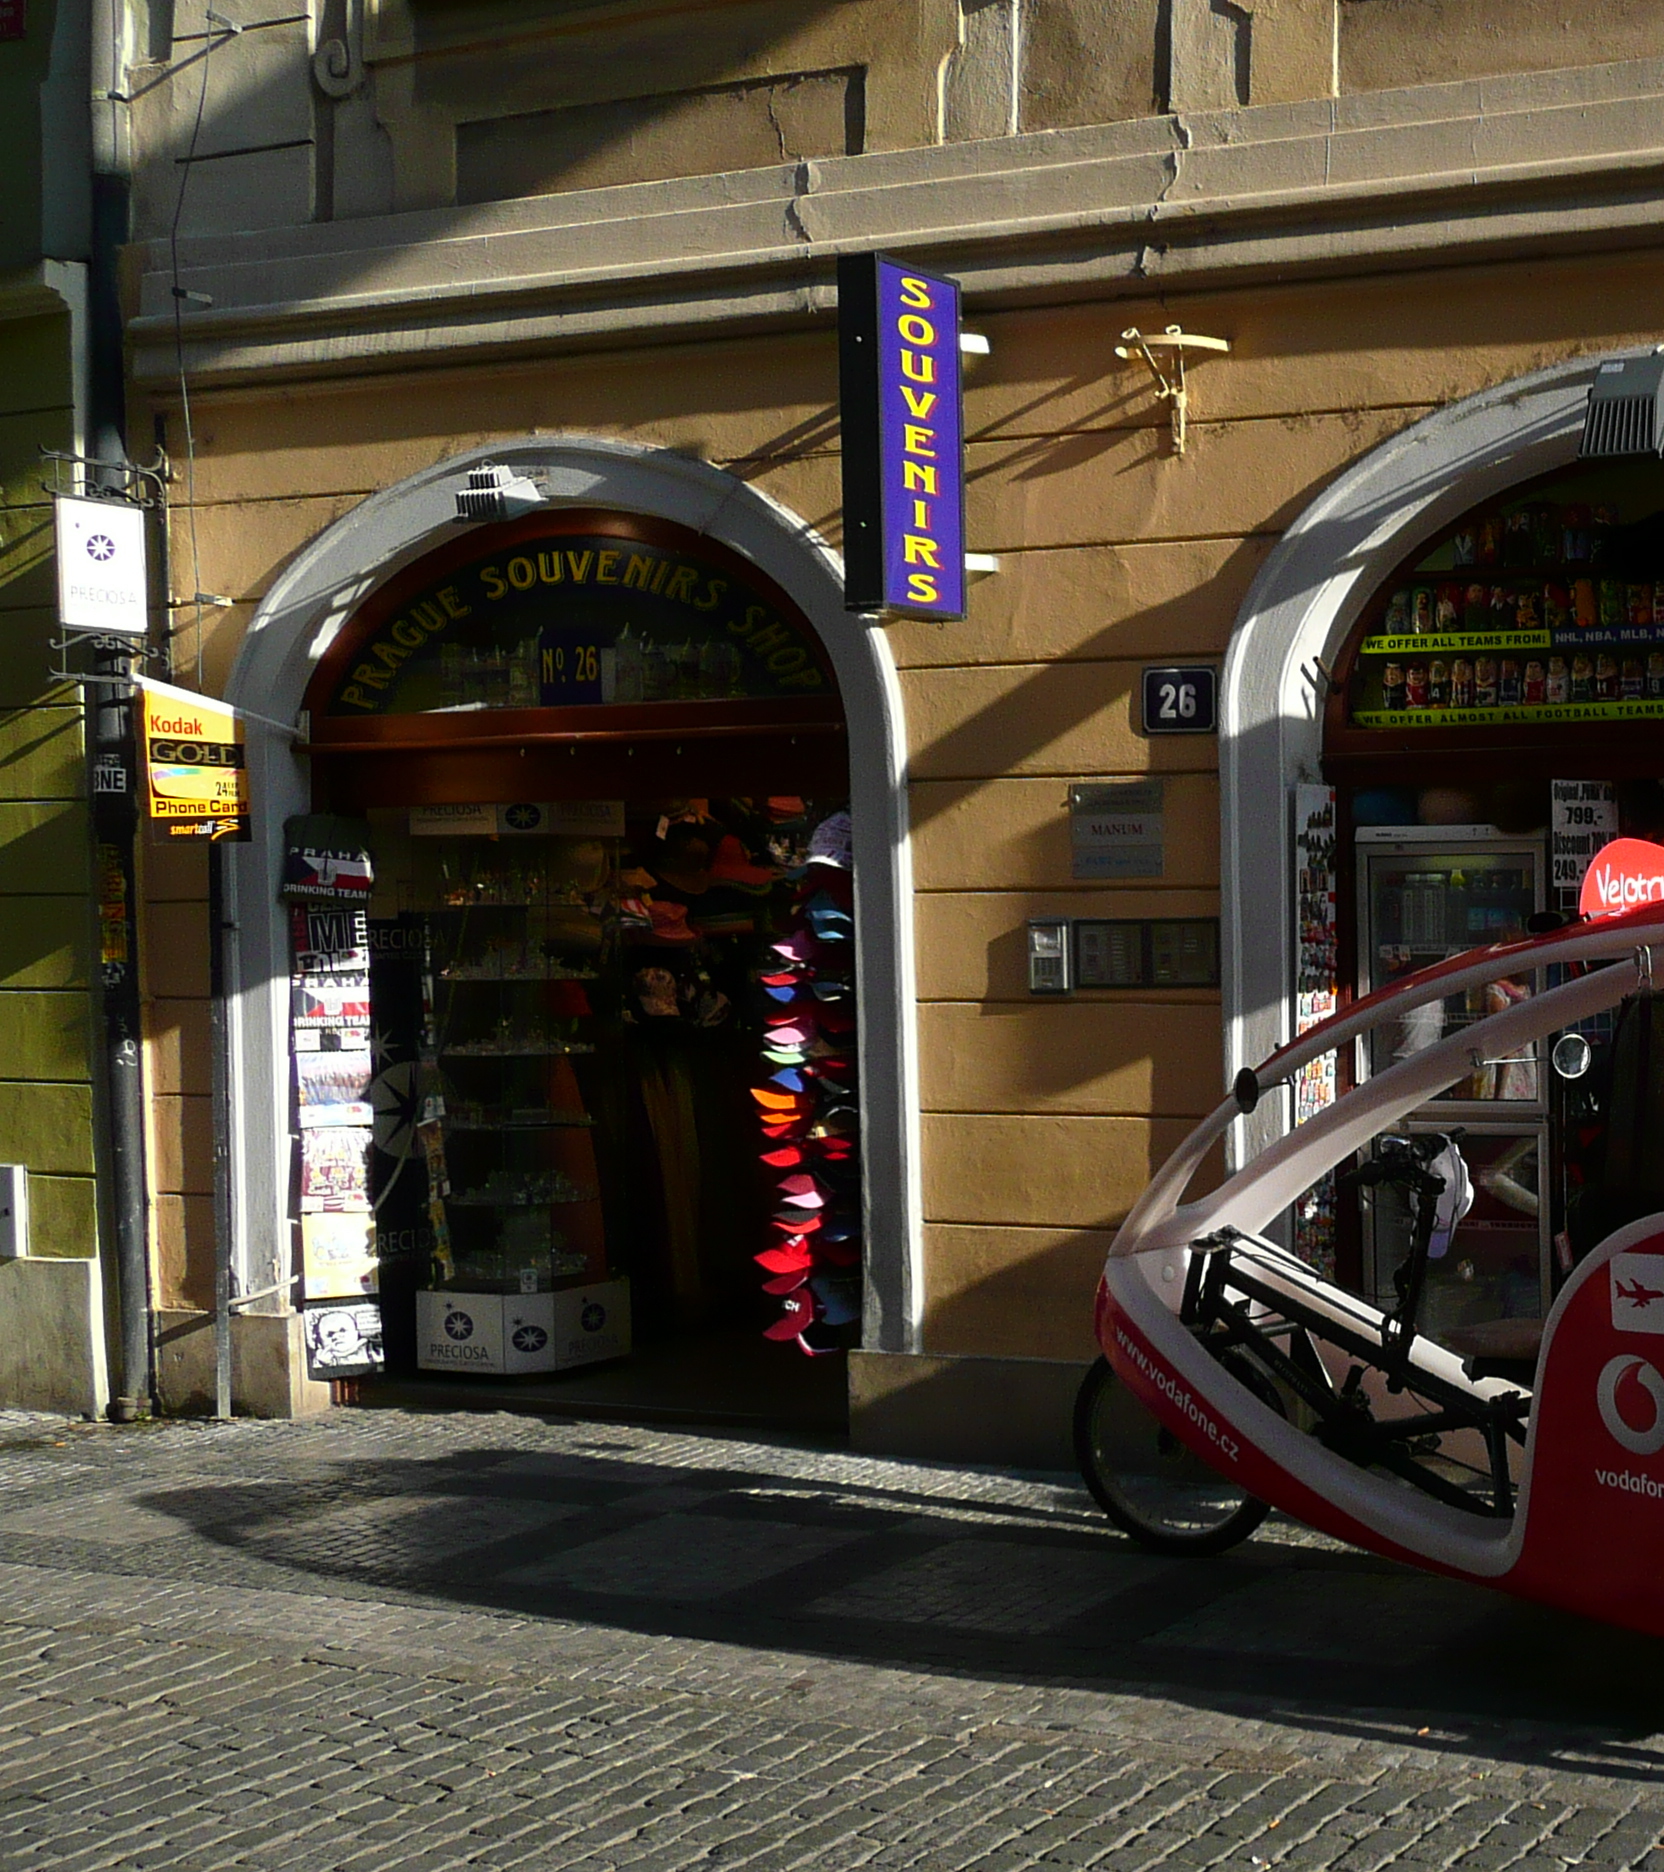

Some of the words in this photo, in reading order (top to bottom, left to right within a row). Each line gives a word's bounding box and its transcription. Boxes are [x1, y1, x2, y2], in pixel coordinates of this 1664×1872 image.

[898, 277, 944, 603] SOUVENIRS
[341, 585, 472, 710] PRAGUE
[480, 549, 728, 611] SOUVENIRS
[728, 605, 822, 687] SHOP
[1366, 639, 1385, 650] WE
[1388, 637, 1428, 649] OFFER
[1431, 636, 1456, 648] ALL
[1459, 635, 1502, 647] TEAMS
[574, 645, 598, 682] 26
[1159, 683, 1197, 718] 26
[150, 714, 203, 735] Kodak
[1363, 715, 1383, 725] WE
[1390, 714, 1432, 725] OFFER
[1441, 711, 1494, 723] ALMOST
[1503, 709, 1528, 721] ALL
[1536, 706, 1608, 719] FOOTBALL
[1617, 703, 1664, 716] TEAMS
[152, 741, 238, 764] GOLD
[155, 800, 207, 815] Phone
[210, 799, 248, 814] Card
[289, 846, 368, 862] PRAHA
[430, 1343, 490, 1361] PRECIOSA
[1115, 1325, 1240, 1463] www.vodafone.cz
